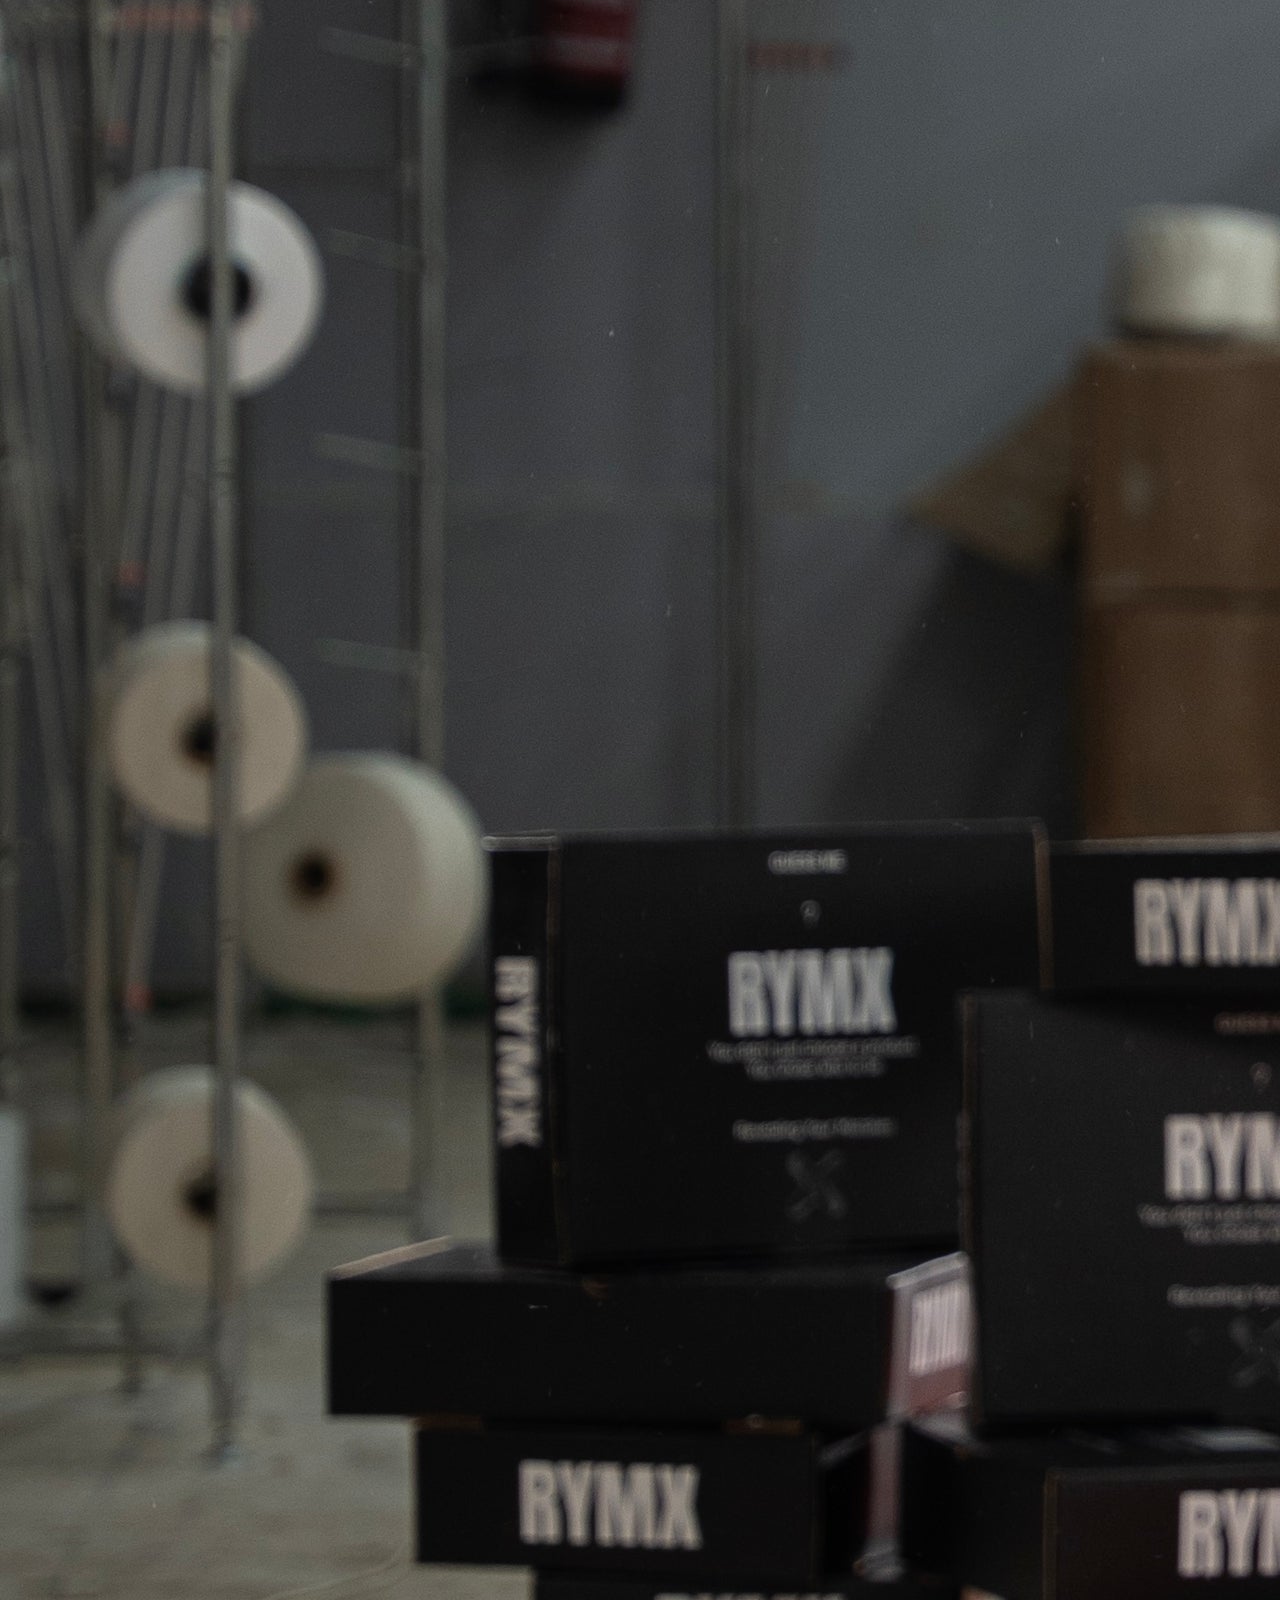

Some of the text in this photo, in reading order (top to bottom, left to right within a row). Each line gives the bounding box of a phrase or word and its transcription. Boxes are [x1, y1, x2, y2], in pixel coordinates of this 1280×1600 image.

[727, 947, 897, 1037] RYMX
[496, 956, 540, 1147] RYMX
[518, 1459, 701, 1550] RYMX
